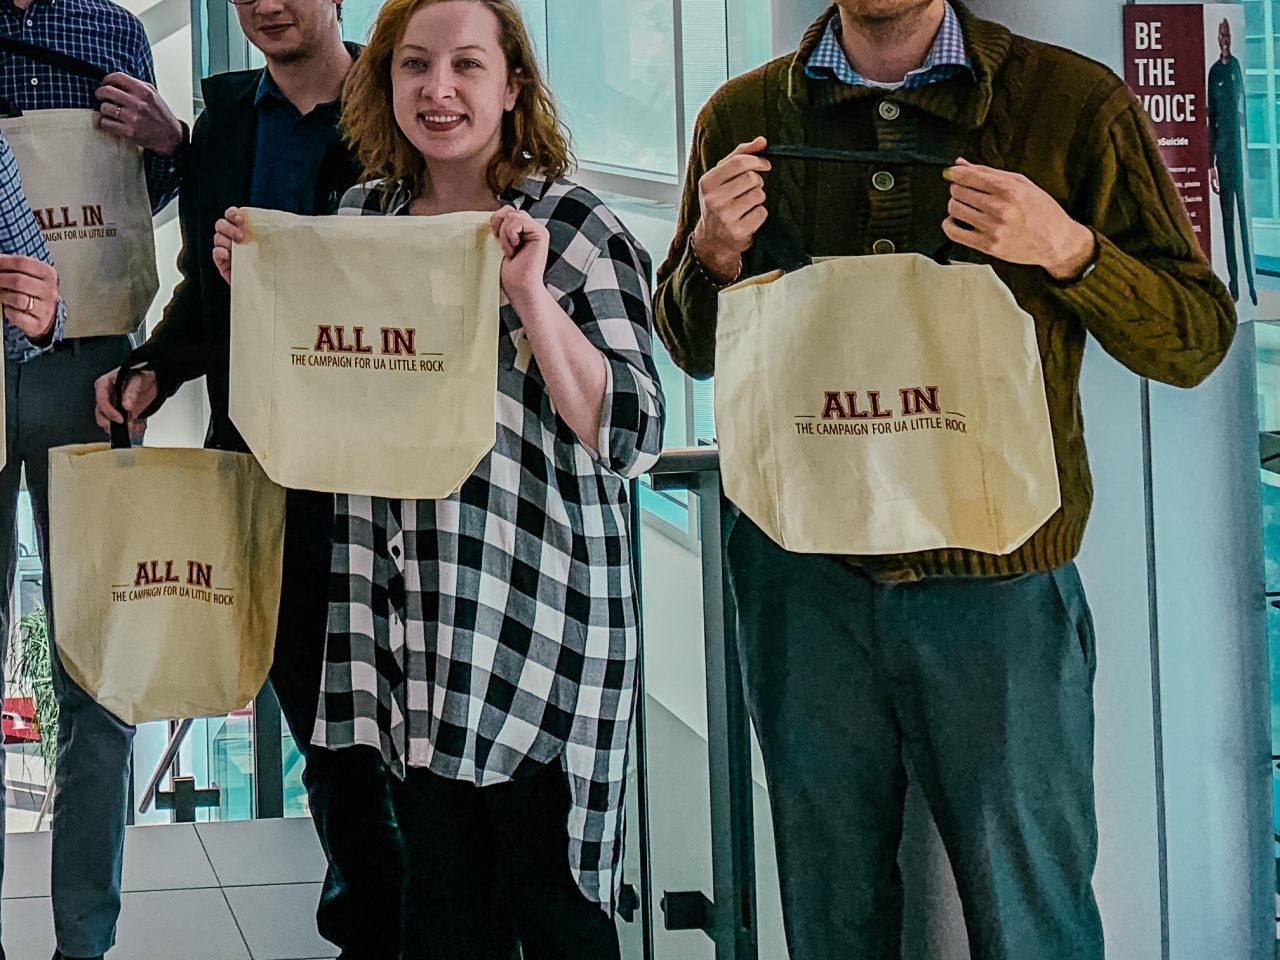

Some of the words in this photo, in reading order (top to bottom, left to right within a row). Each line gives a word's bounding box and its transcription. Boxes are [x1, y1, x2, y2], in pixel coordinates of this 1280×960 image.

[1135, 22, 1162, 50] BE
[1135, 58, 1175, 86] THE
[81, 204, 105, 226] IN
[64, 231, 77, 240] FOR
[79, 230, 87, 239] UA
[88, 229, 104, 238] LITTLE
[314, 325, 373, 354] ALL
[380, 327, 416, 357] IN
[291, 354, 306, 366] THE
[308, 355, 352, 368] CAMPAIGN
[354, 357, 370, 369] FOR
[373, 359, 386, 370] UA
[389, 359, 417, 371] LITTLE
[420, 360, 445, 372] ROCK
[821, 391, 892, 420] ALL
[899, 386, 941, 416] IN
[795, 422, 814, 434] THE
[816, 423, 869, 436] CAMPAIGN
[872, 422, 892, 435] FOR
[894, 420, 908, 432] UA
[910, 417, 942, 431] LITTLE
[945, 419, 968, 434] ROCK
[133, 561, 179, 587] ALL
[187, 560, 213, 589] IN
[112, 591, 127, 602] THE
[129, 587, 162, 601] CAMPAIGN
[163, 585, 178, 596] FOR
[179, 587, 190, 597] UA
[191, 590, 212, 603] LITTLE
[214, 595, 234, 606] ROCK
